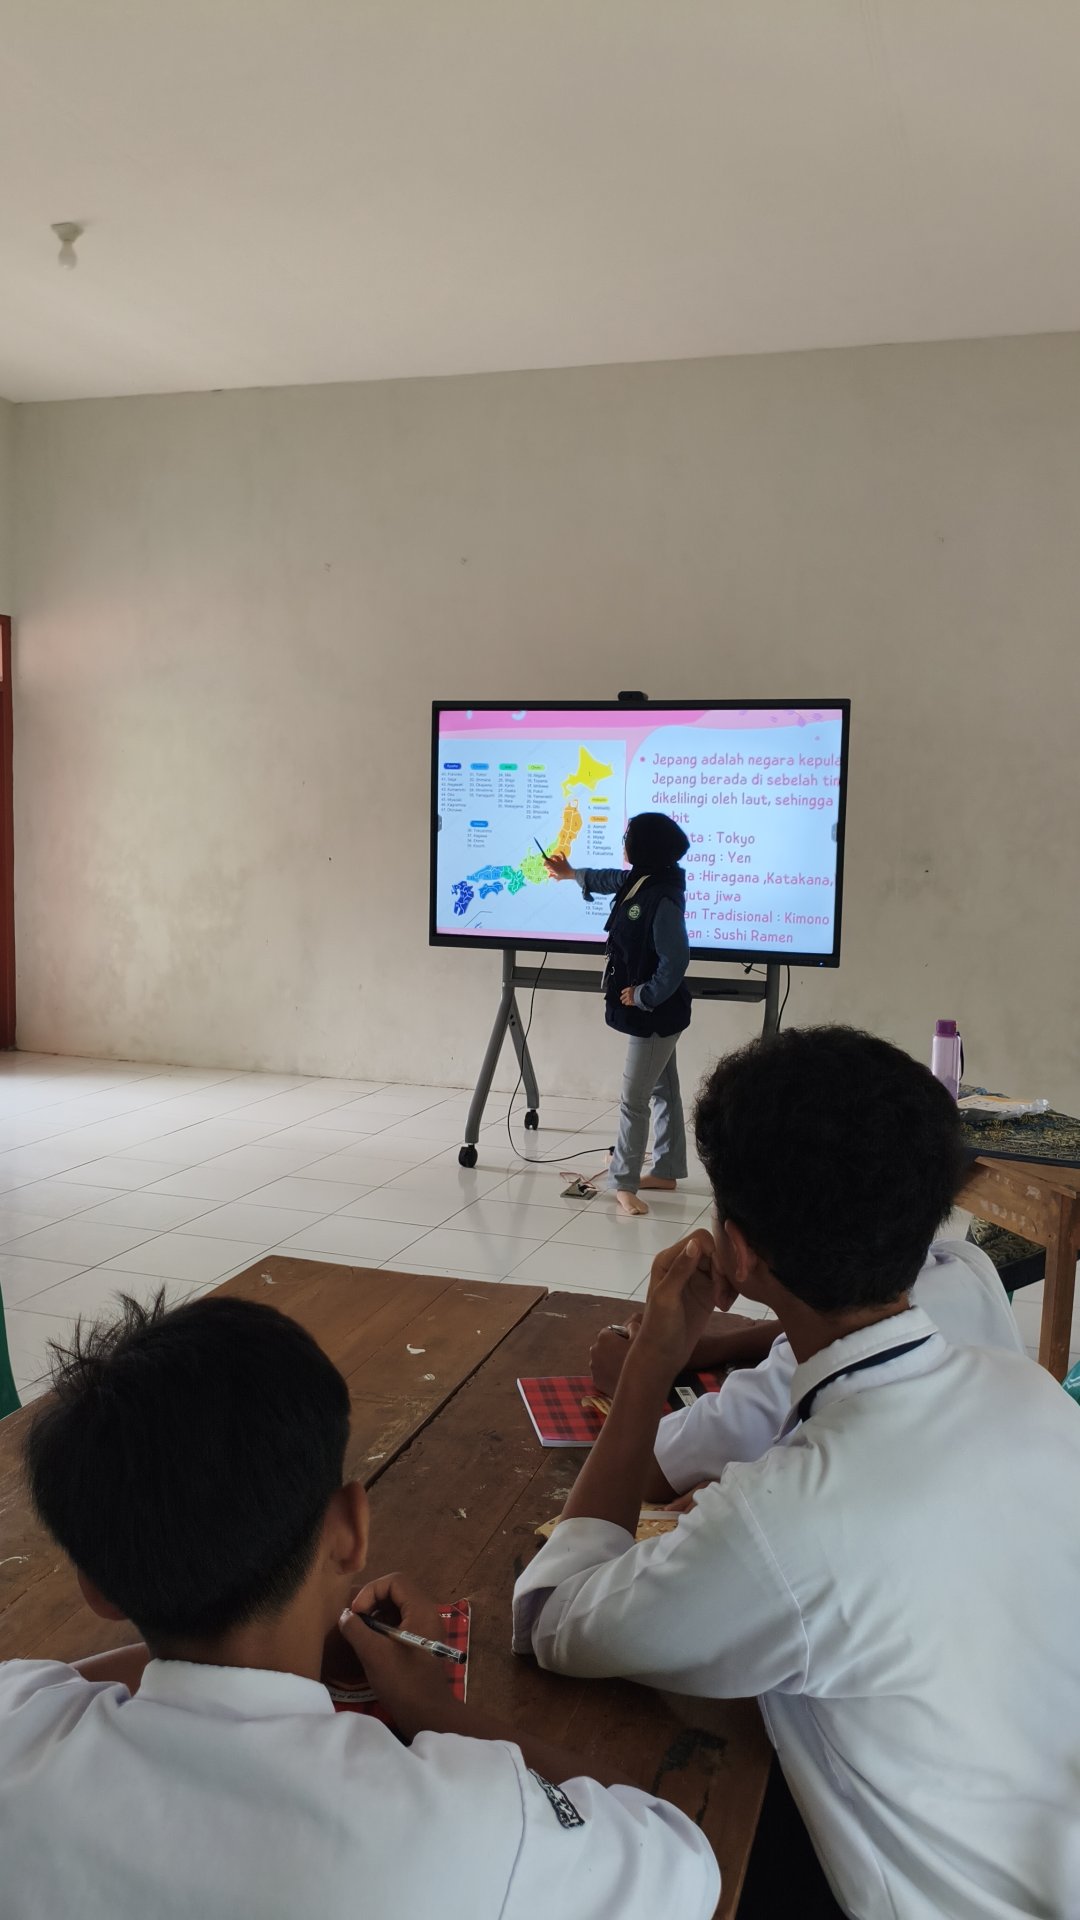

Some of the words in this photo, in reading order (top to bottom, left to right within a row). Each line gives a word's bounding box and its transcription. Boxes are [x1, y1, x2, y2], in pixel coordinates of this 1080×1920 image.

[652, 753, 697, 768] Jepang
[701, 753, 744, 766] adalah
[749, 755, 795, 770] negara
[652, 772, 697, 788] Jepang
[700, 772, 748, 785] berada
[751, 773, 763, 785] di
[766, 773, 818, 787] sebelah
[651, 792, 708, 808] dikelilingi
[711, 792, 738, 805] oleh
[741, 792, 772, 807] laut,
[775, 794, 834, 810] sehingga
[716, 831, 756, 847] Tokyo
[687, 852, 716, 867] uang
[728, 851, 752, 864] Yen
[714, 891, 742, 904] jiwa
[702, 908, 773, 923] Tradisional
[784, 912, 831, 926] Kimono
[713, 928, 747, 941] Sushi
[751, 930, 794, 944] Ramen
